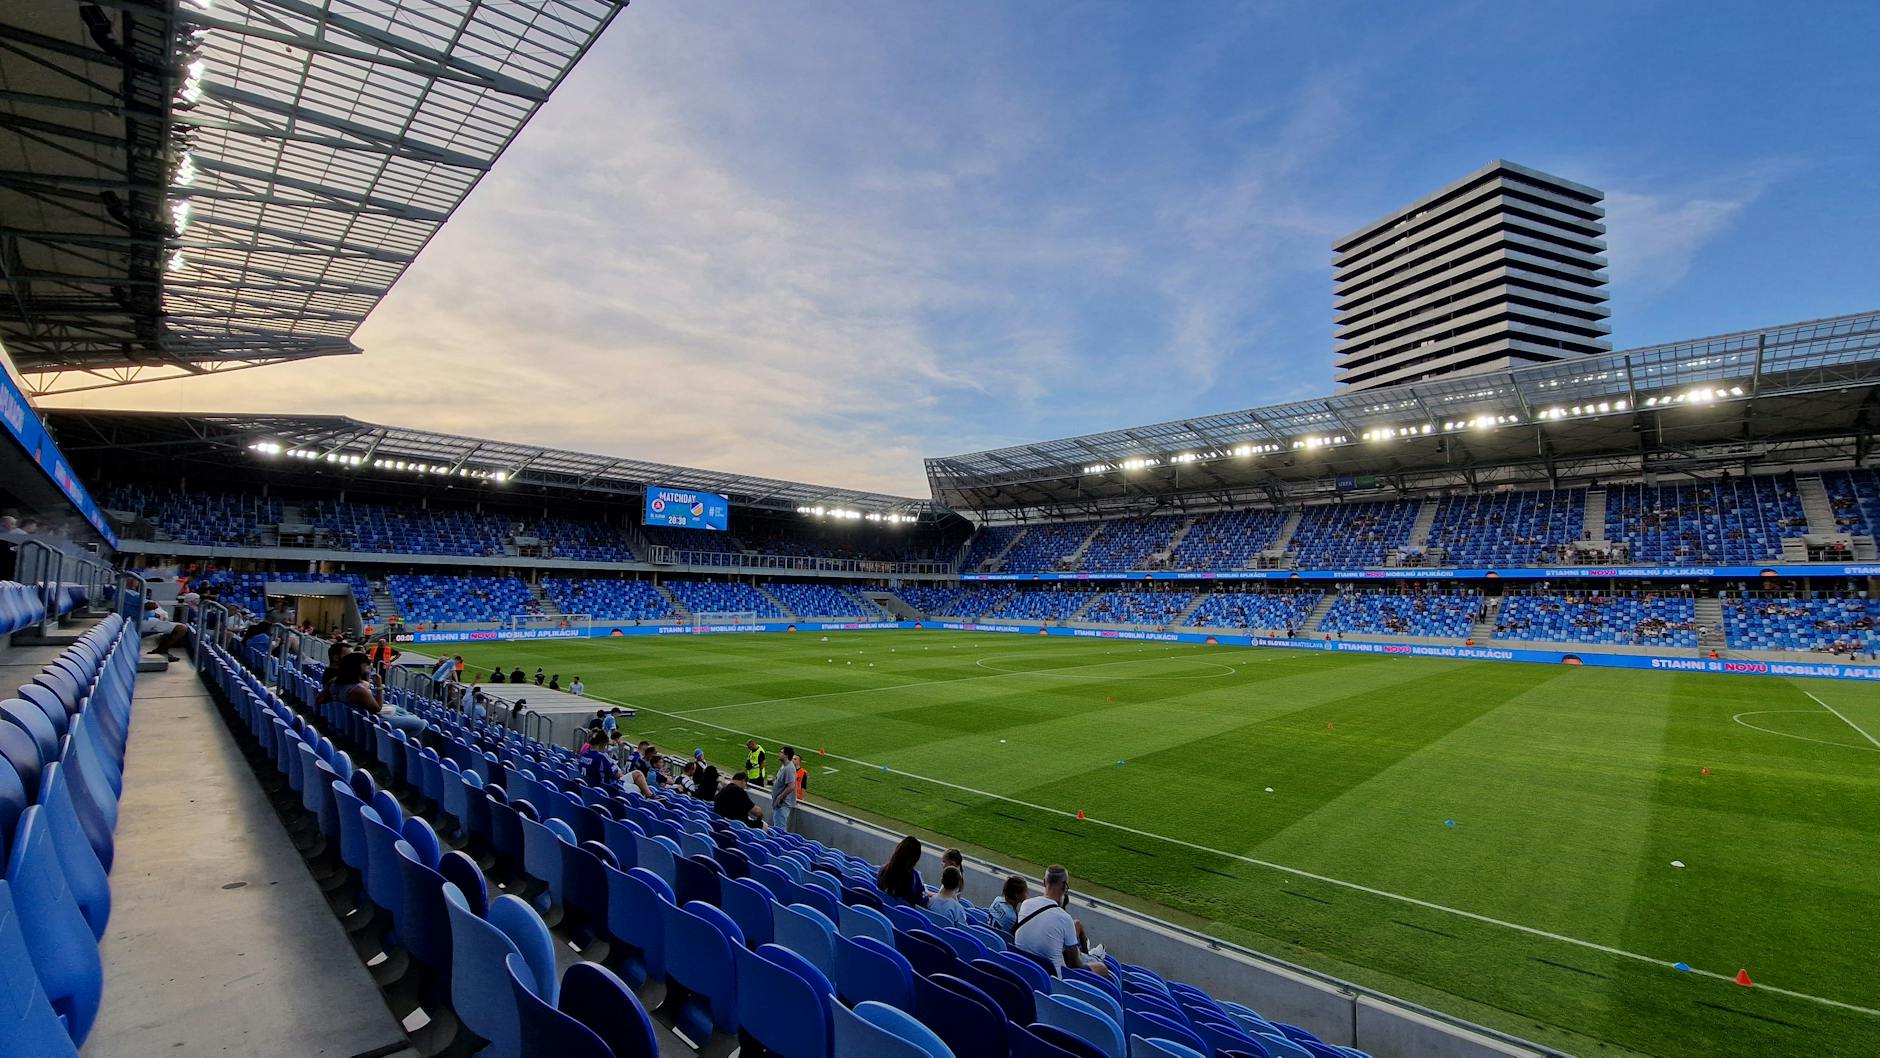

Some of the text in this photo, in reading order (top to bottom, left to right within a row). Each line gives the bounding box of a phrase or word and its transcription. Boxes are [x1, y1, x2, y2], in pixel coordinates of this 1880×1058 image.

[659, 491, 697, 504] MATCHDAY
[668, 516, 687, 525] 20:30
[1618, 568, 1660, 576] MOBILNÚ
[1662, 567, 1714, 575] APLIKÁCIU
[396, 634, 414, 642] 00:00
[420, 632, 459, 641] STIAHNI
[498, 629, 536, 639] MOBILNÚ
[537, 627, 579, 637] APLIKÁCIU
[1290, 641, 1324, 649] BRATISLAVA
[1338, 643, 1372, 652] STIAHNI
[1412, 645, 1456, 656] MOBILNÚ
[1458, 648, 1513, 659] APLIKÁCIU
[1651, 659, 1706, 670] STIAHNI
[1708, 661, 1722, 671] SI
[1725, 661, 1768, 673] NOVÚ
[1771, 664, 1840, 676] MOBILNÚ
